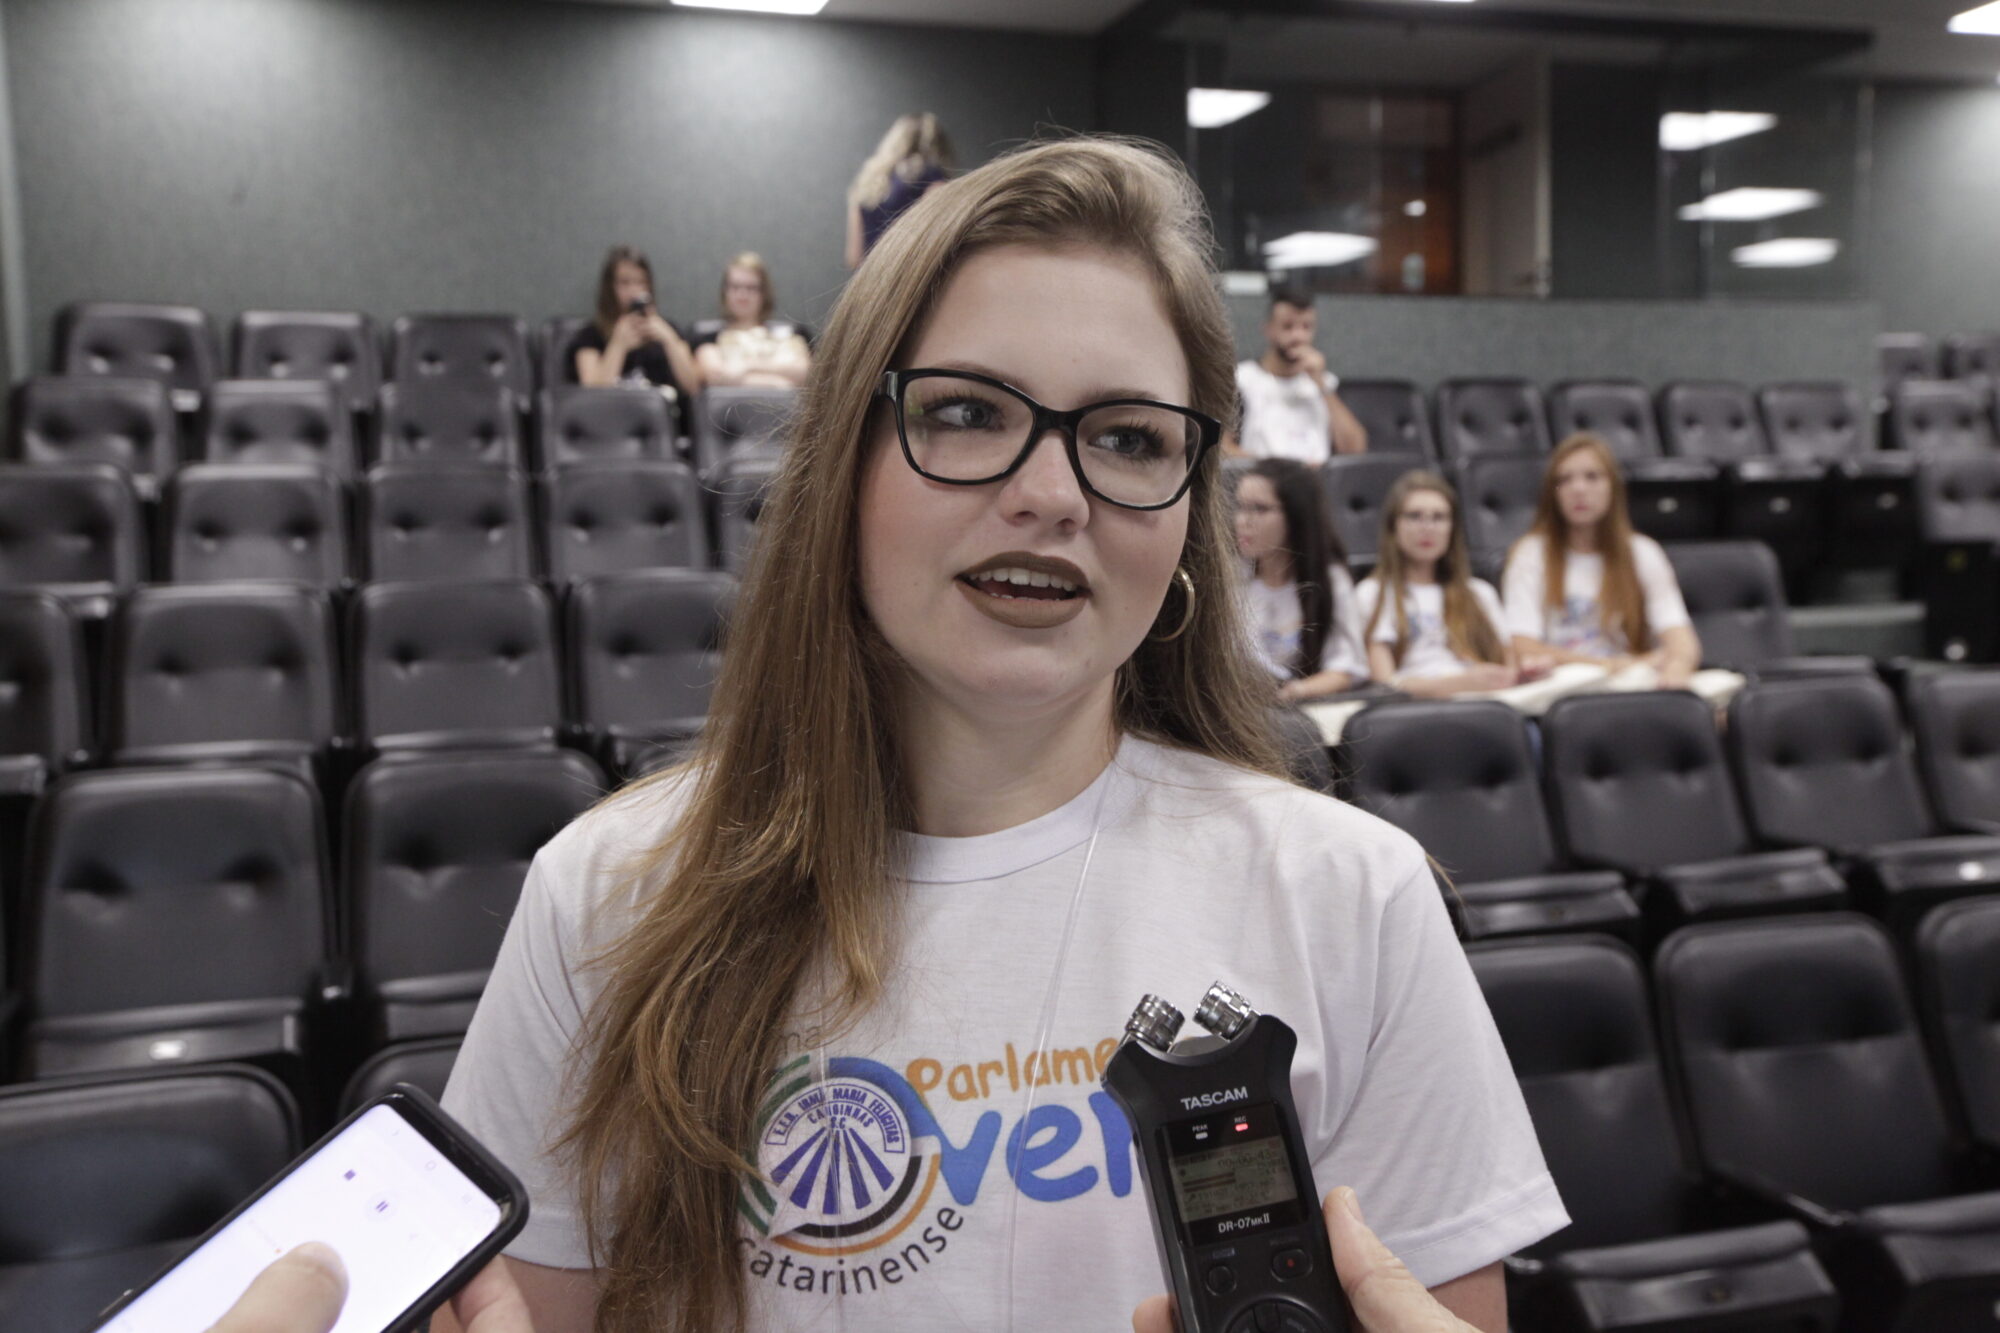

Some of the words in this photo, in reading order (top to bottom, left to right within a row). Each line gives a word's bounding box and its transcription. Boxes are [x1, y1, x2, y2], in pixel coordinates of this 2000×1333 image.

[832, 1087, 868, 1105] MARIA
[1180, 1086, 1248, 1110] TASCAM
[1234, 1115, 1247, 1123] REC
[1192, 1124, 1208, 1132] PEAK
